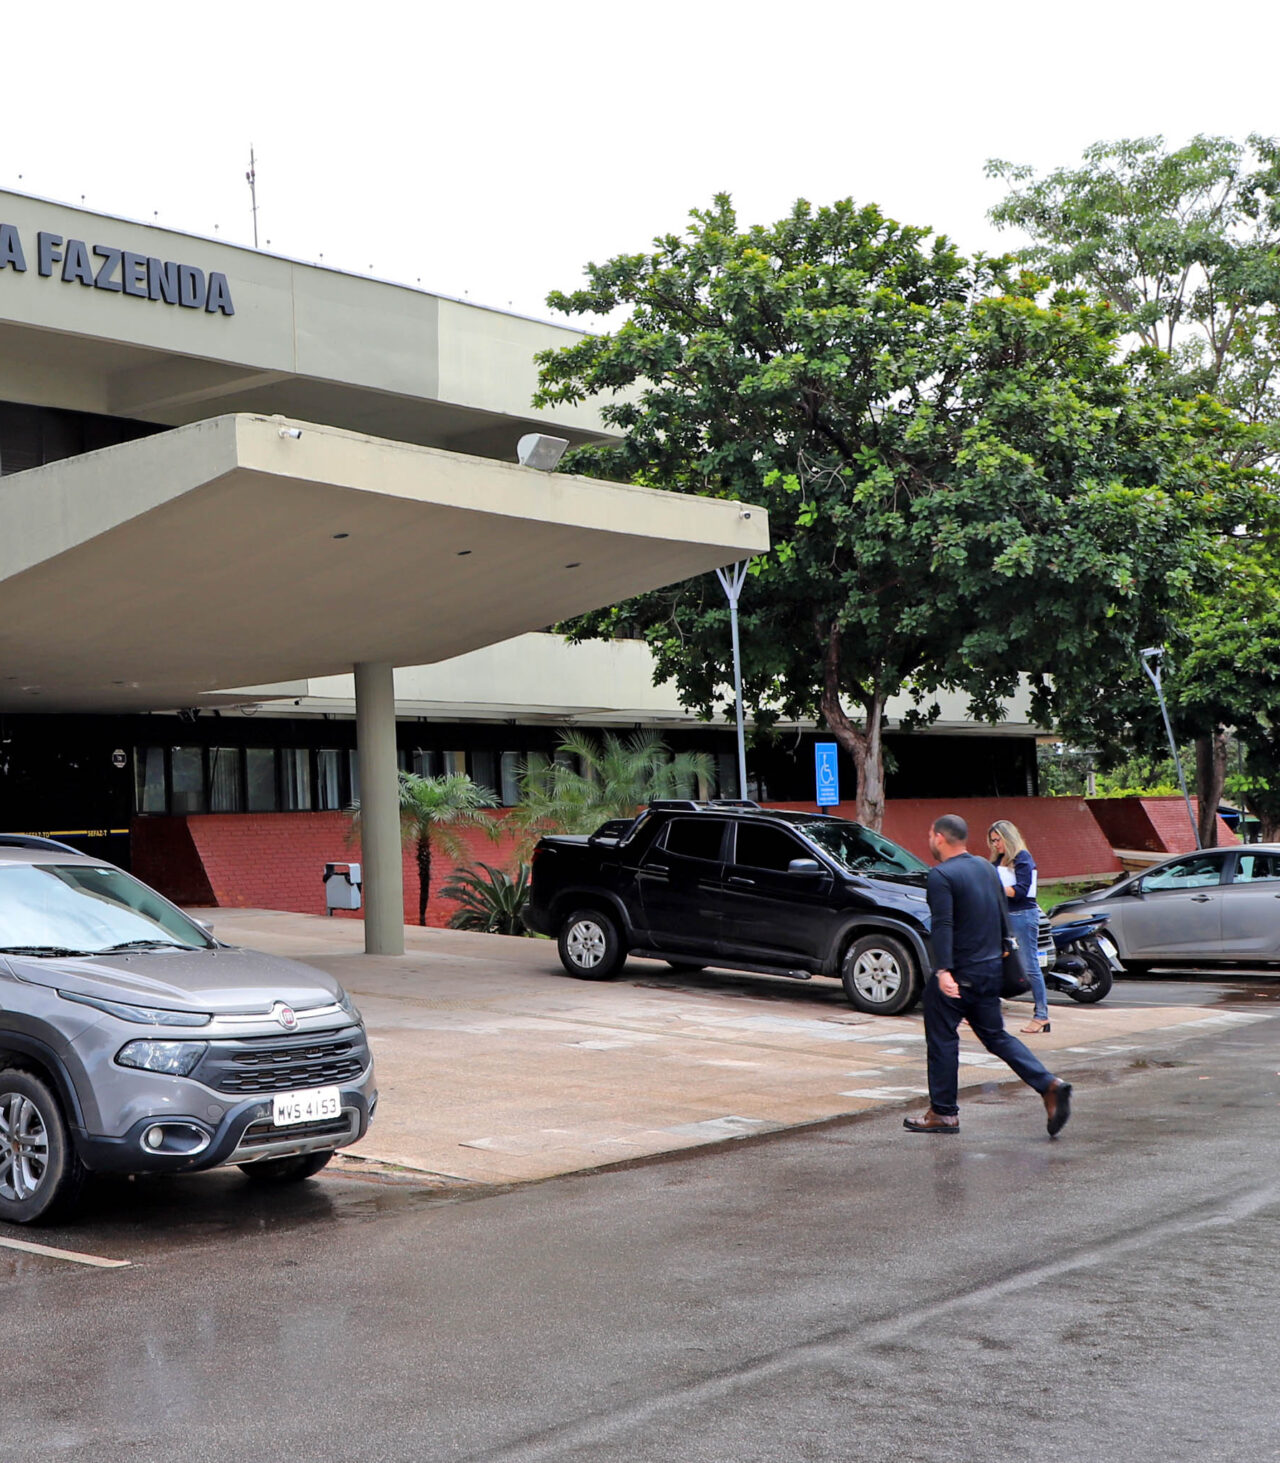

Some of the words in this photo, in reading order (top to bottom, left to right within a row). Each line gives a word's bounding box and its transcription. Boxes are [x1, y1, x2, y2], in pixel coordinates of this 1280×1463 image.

[37, 231, 235, 315] FAZENDA
[278, 1103, 301, 1121] MVS
[306, 1098, 337, 1117] 4153
